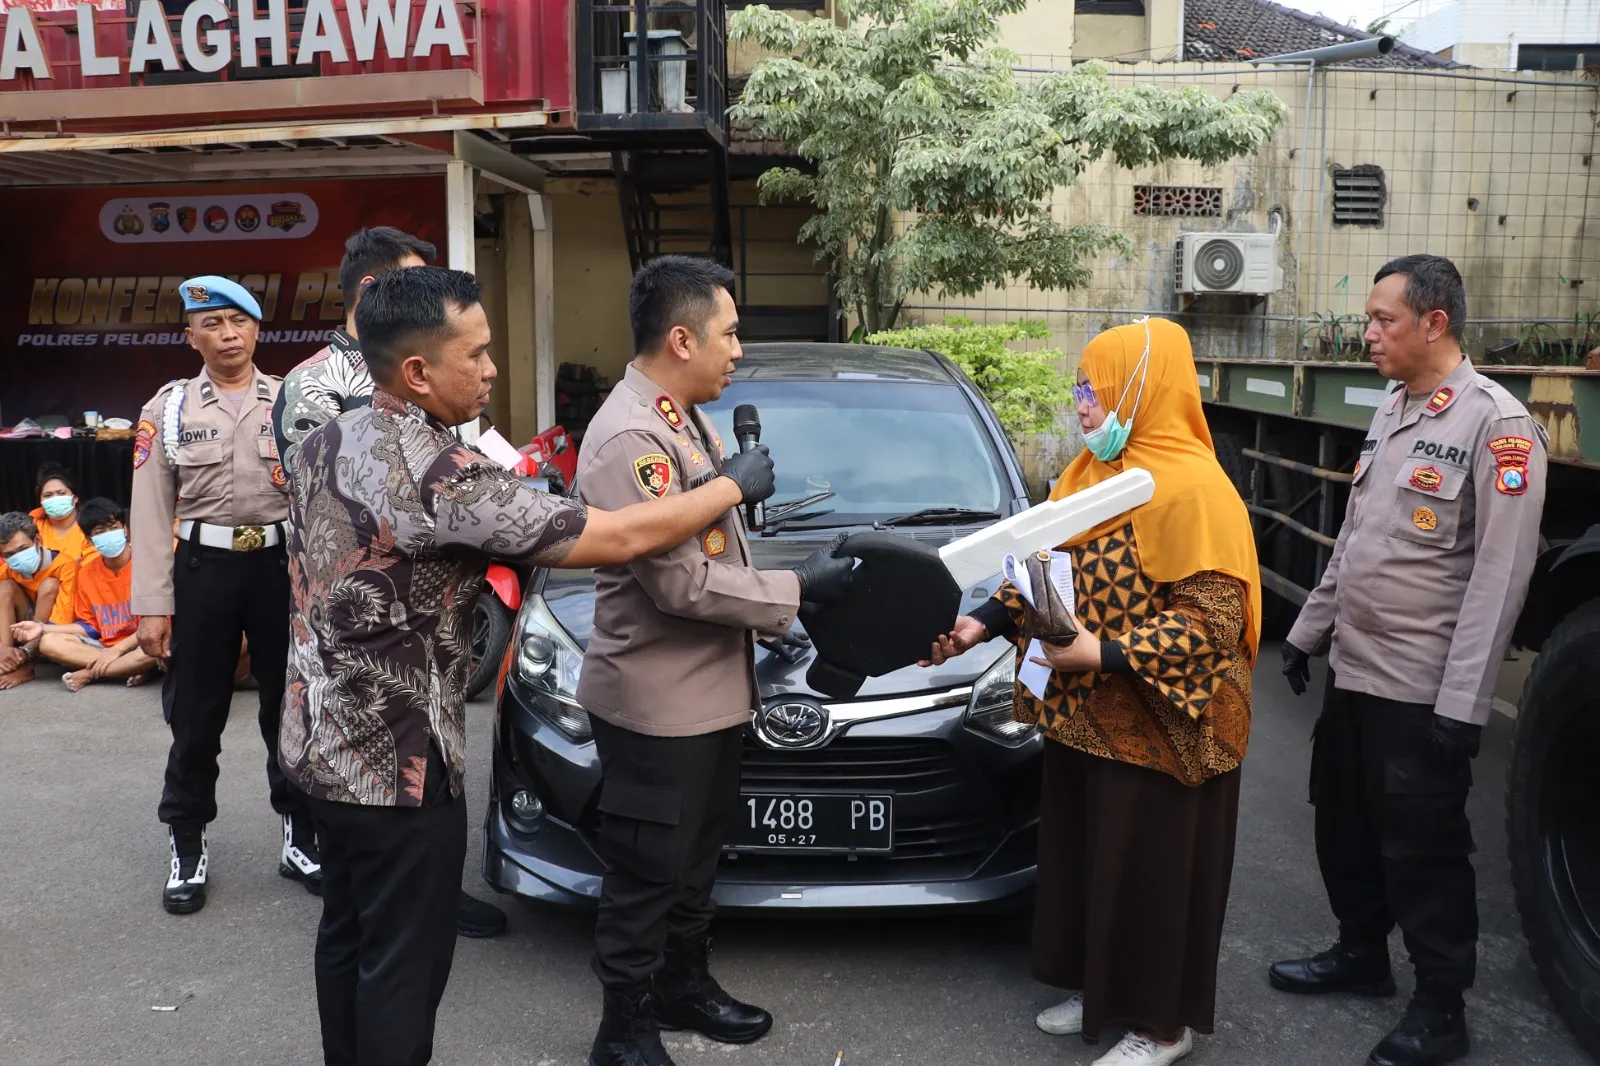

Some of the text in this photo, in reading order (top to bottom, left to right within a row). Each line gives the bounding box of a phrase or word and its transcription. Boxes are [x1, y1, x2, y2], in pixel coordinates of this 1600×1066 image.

[77, 0, 469, 76] LAGHAWA
[28, 273, 282, 325] KONFERSI
[17, 334, 99, 346] POLRES
[103, 332, 189, 346] PELABU
[1412, 440, 1467, 464] POLRI
[747, 798, 885, 831] 1488 PB
